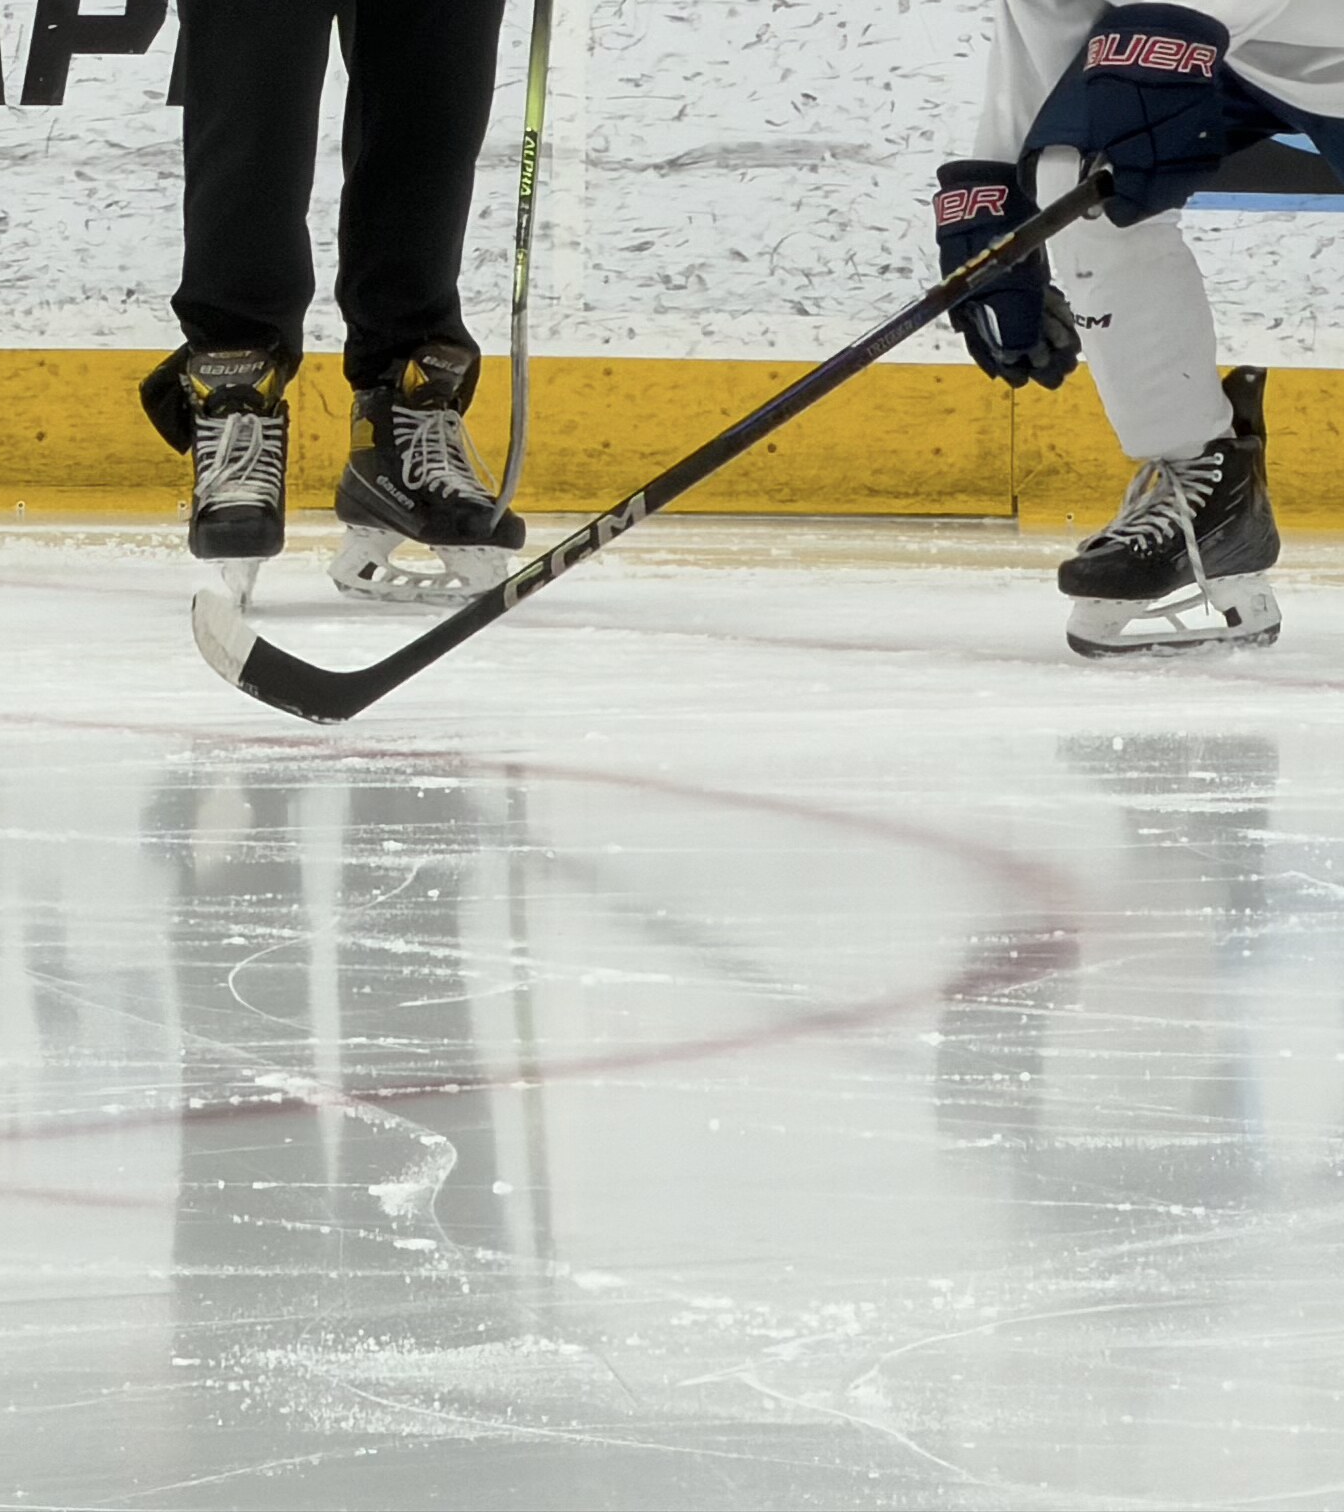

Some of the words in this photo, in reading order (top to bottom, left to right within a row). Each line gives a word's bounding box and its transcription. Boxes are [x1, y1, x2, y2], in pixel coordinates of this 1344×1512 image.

[520, 134, 537, 196] ALPHA
[933, 185, 1010, 227] ER
[503, 491, 647, 609] CCM
